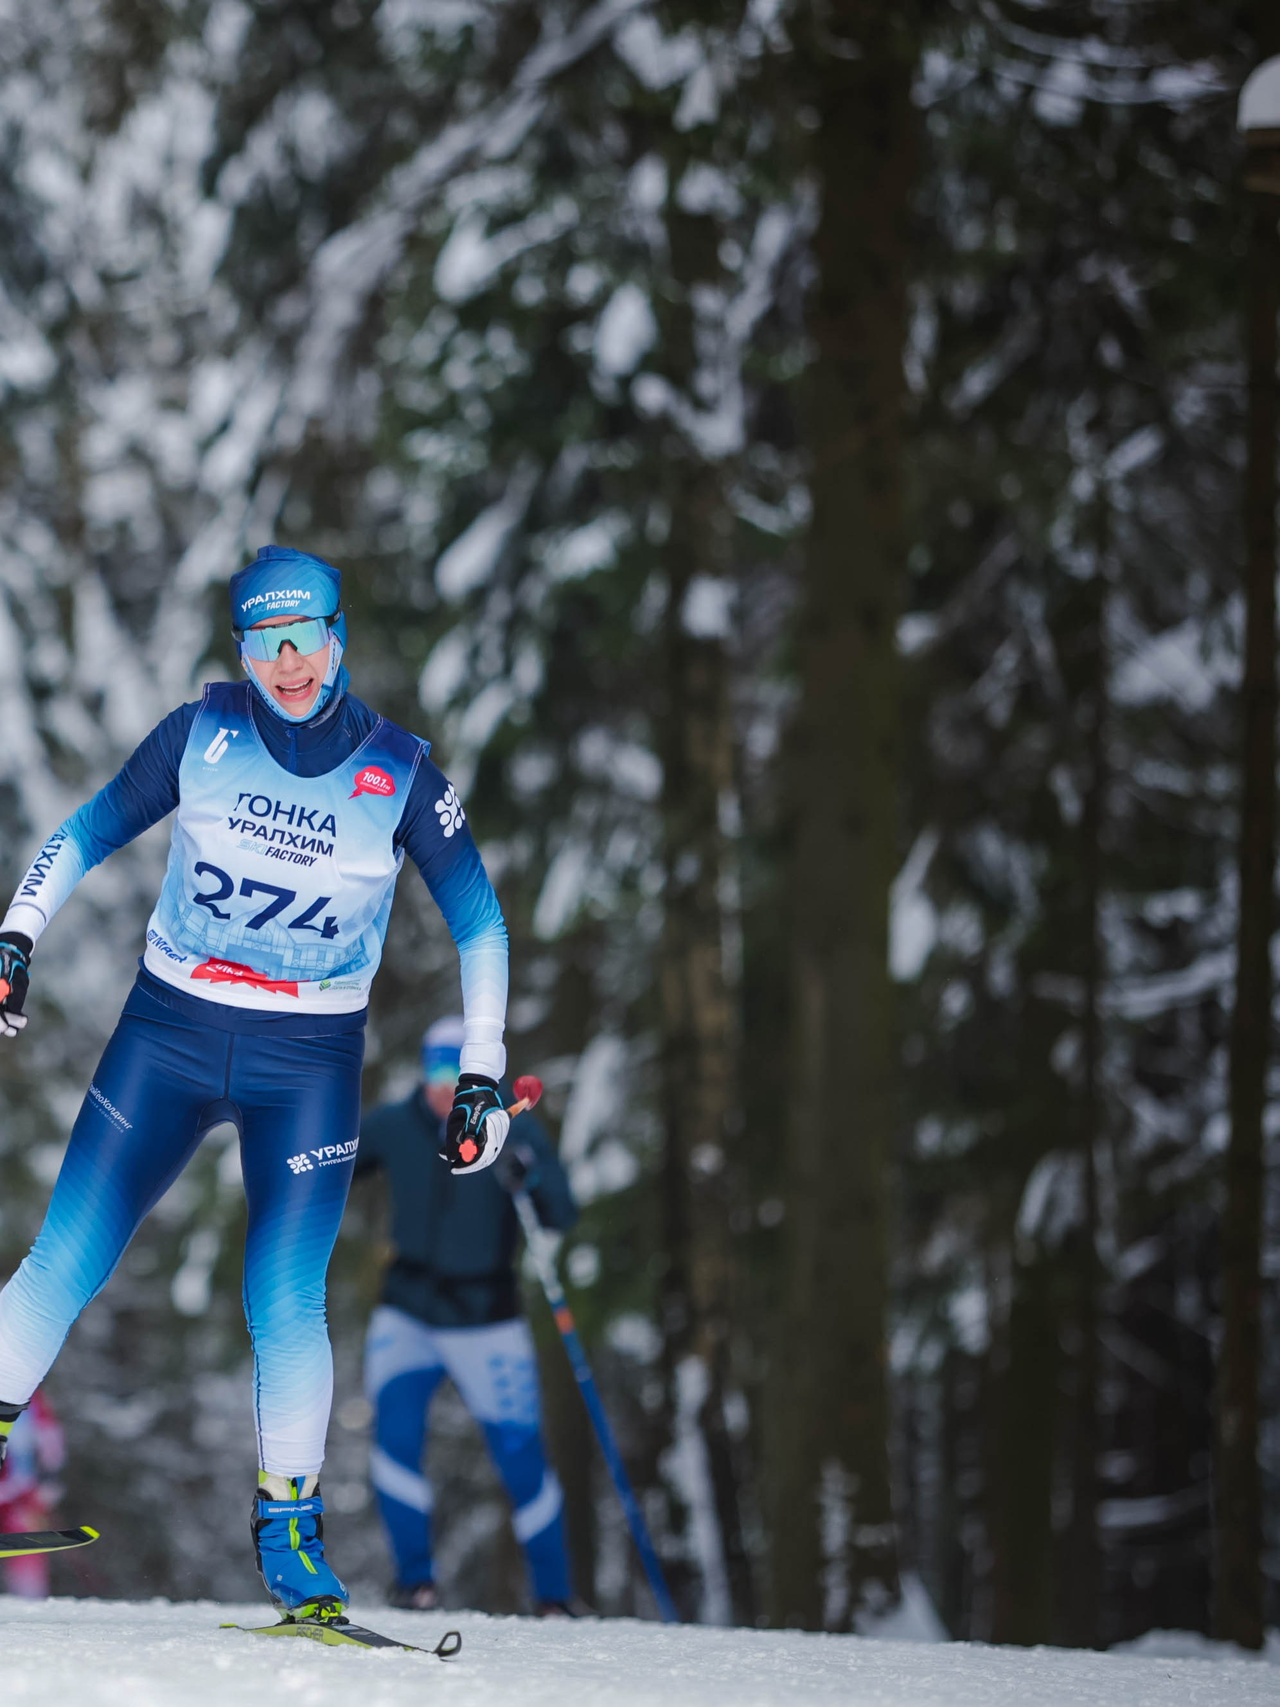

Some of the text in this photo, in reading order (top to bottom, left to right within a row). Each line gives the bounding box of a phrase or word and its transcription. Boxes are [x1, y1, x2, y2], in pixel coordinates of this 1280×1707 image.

[241, 589, 311, 613] УРАЛХИМ
[233, 792, 337, 838] ГОНКА
[227, 816, 335, 858] УРАЛХИМ
[264, 846, 318, 867] FACTORY
[192, 861, 340, 940] 274
